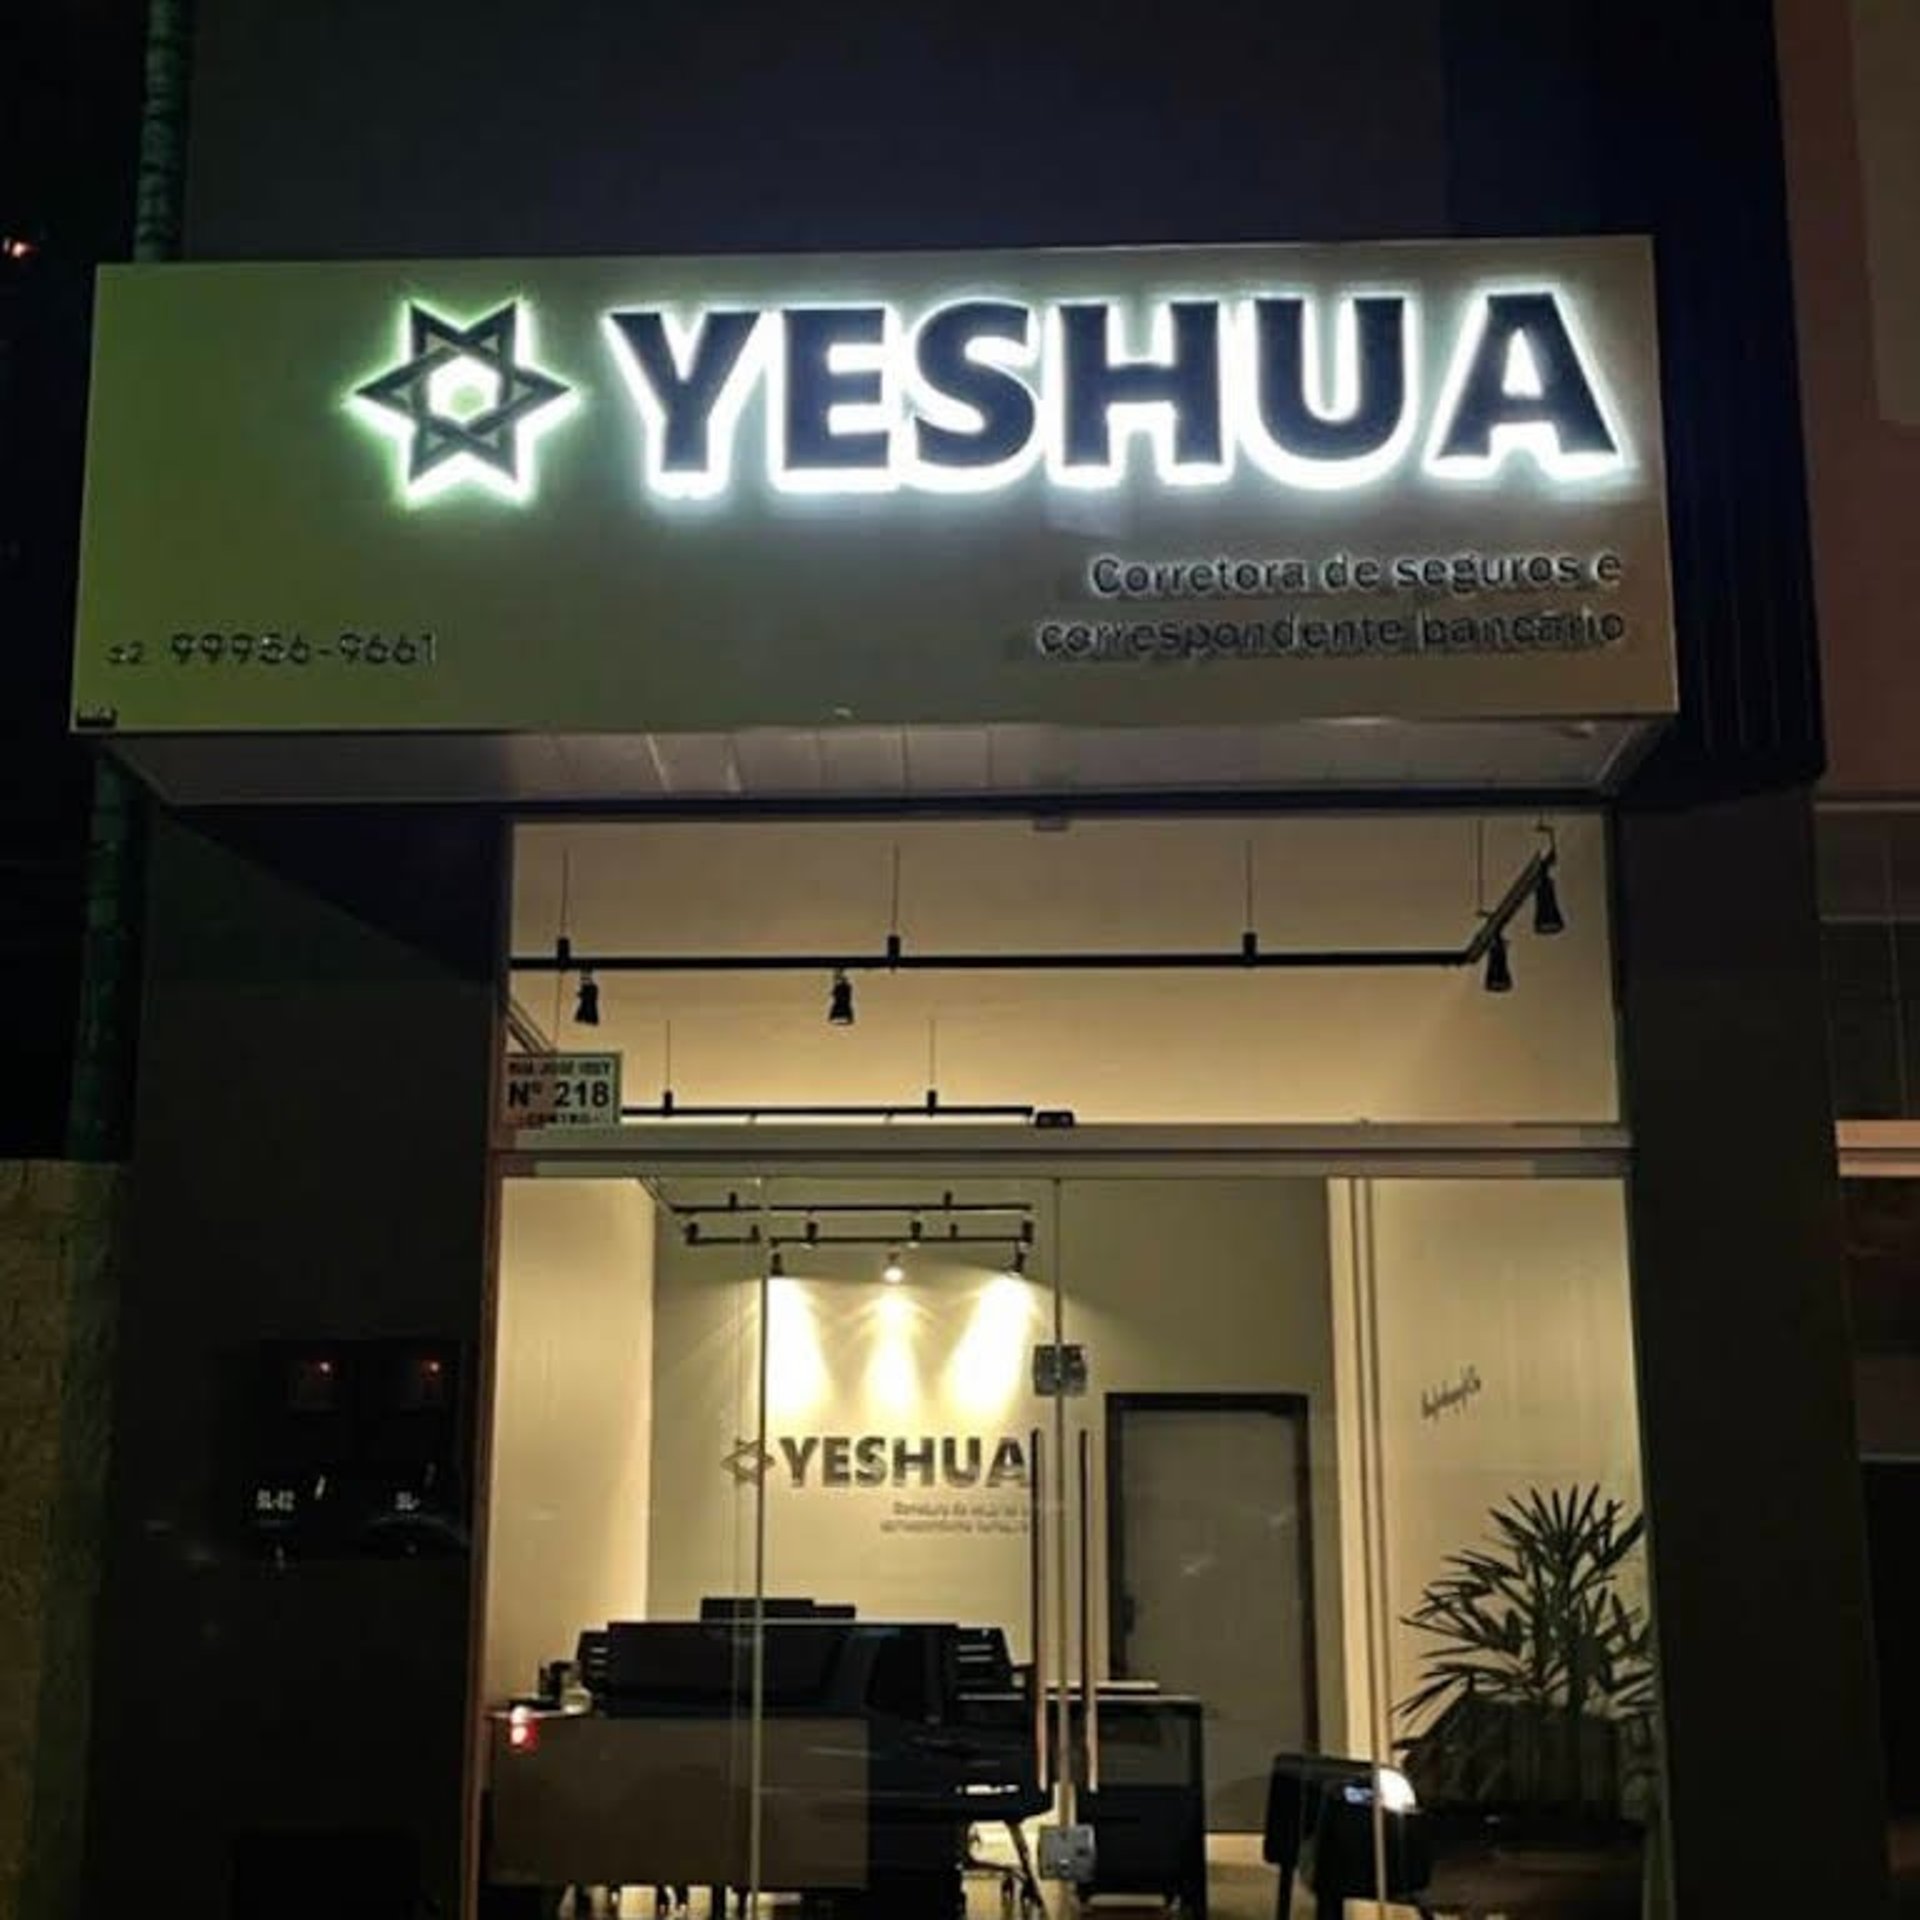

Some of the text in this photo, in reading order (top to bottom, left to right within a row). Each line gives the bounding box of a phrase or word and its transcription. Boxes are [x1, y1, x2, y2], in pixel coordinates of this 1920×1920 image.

[608, 290, 1620, 474] YESHUA
[1091, 552, 1622, 596] Corretora de seguros e
[1038, 612, 1404, 660] correspondente
[553, 1080, 610, 1108] 218
[778, 1436, 1031, 1488] YESHUA
